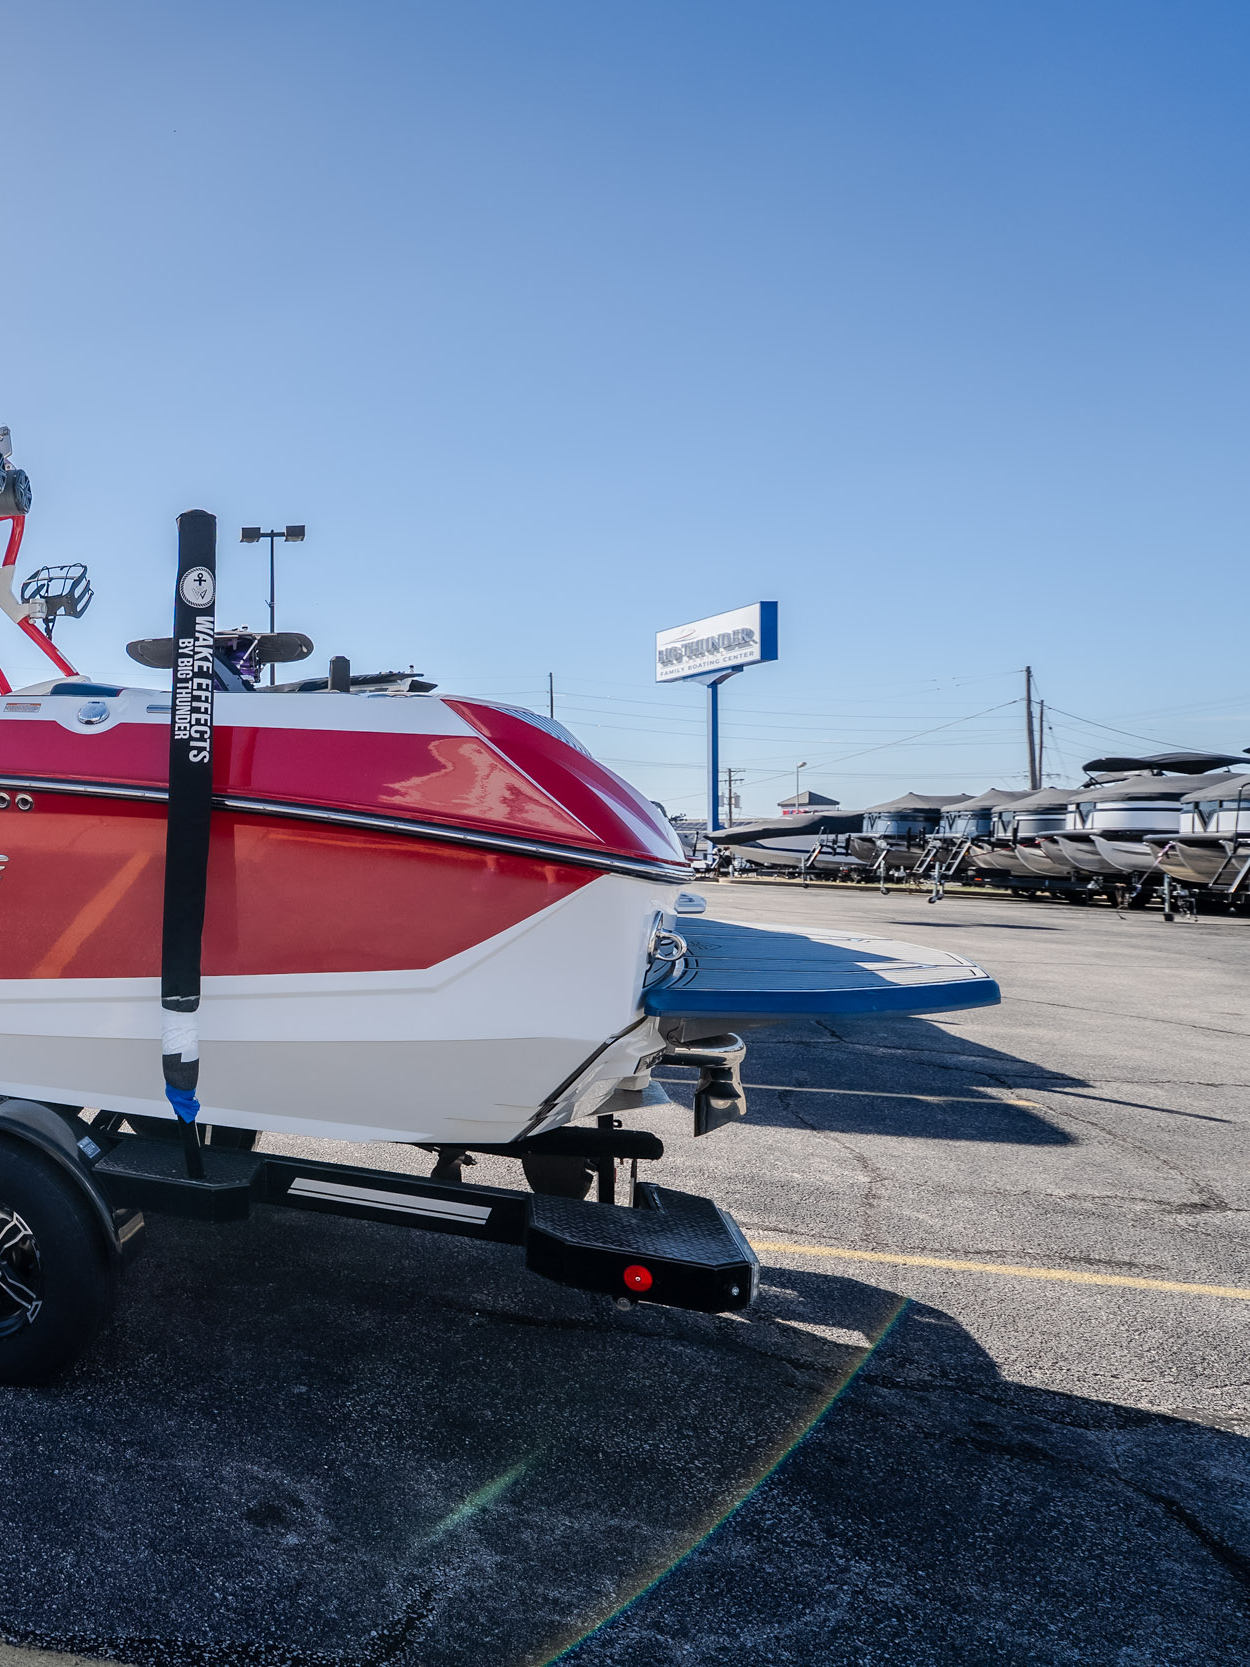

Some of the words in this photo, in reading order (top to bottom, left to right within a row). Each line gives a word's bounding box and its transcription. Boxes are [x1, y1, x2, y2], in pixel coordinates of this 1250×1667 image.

[178, 638, 194, 655] BY
[192, 616, 214, 674] WAKE
[660, 666, 686, 677] FAMILY
[688, 659, 720, 671] BOATING
[723, 650, 754, 663] CENTER
[177, 657, 193, 679] BIG
[174, 680, 192, 739] THUNDER
[188, 678, 212, 764] EFFECTS
